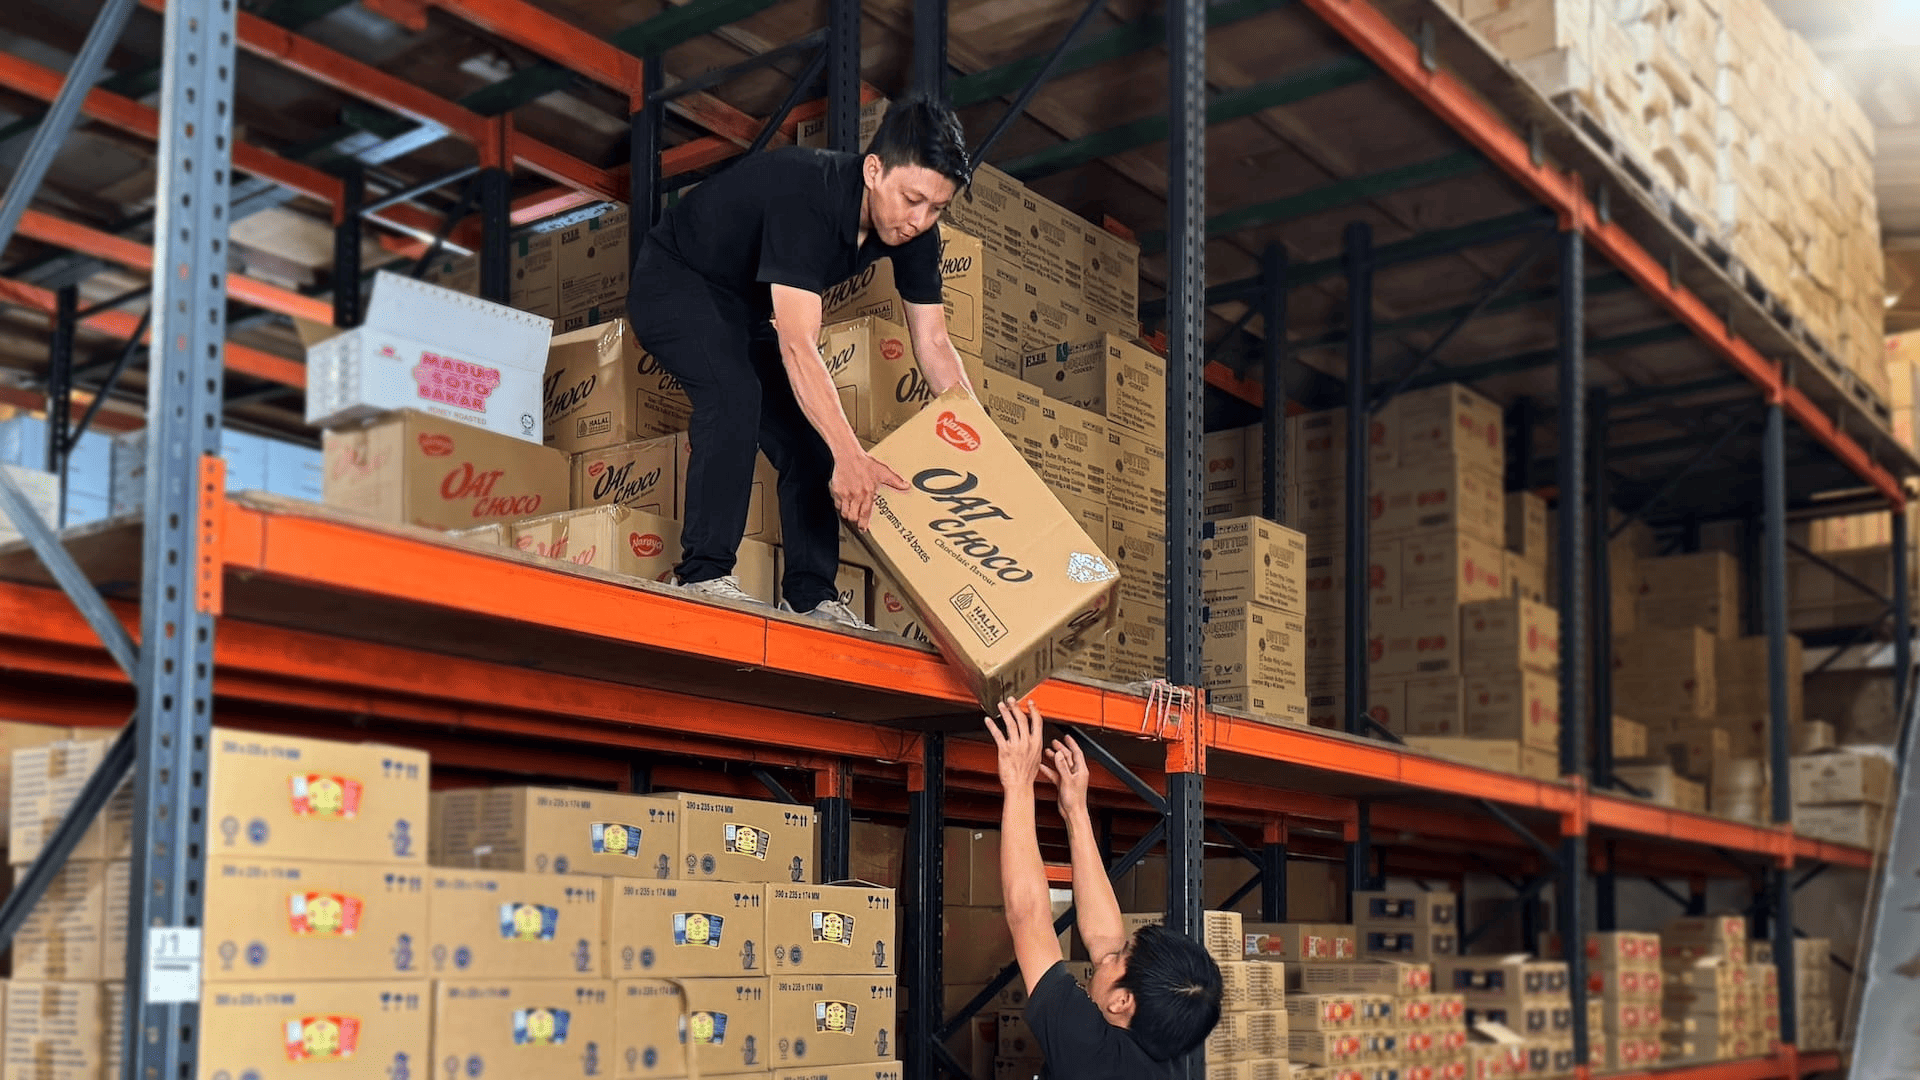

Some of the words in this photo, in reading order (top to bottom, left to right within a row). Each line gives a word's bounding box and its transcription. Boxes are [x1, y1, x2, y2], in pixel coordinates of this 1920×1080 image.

[589, 417, 609, 427] HALAL
[937, 416, 979, 449] Naraya
[440, 462, 504, 500] OAT
[593, 460, 636, 500] OAT
[613, 468, 661, 504] CHOCO
[912, 468, 1013, 522] OAT
[472, 494, 542, 517] CHOCO
[632, 536, 664, 551] Naraya
[903, 530, 914, 543] 24
[911, 538, 931, 563] boxes
[929, 519, 1033, 582] CHOCO
[1213, 536, 1249, 550] BUTTER
[934, 538, 970, 568] Chocolate
[969, 561, 997, 588] flavour
[973, 606, 1000, 638] HALAL
[686, 801, 696, 810] 390
[701, 802, 710, 811] 235
[715, 803, 724, 812] 174
[640, 887, 650, 896] 235
[656, 888, 666, 896] 174
[667, 888, 677, 896] MM
[775, 890, 784, 898] 390
[789, 890, 798, 899] 235
[802, 891, 811, 899] 174
[811, 892, 820, 900] MM
[154, 932, 180, 955] J1
